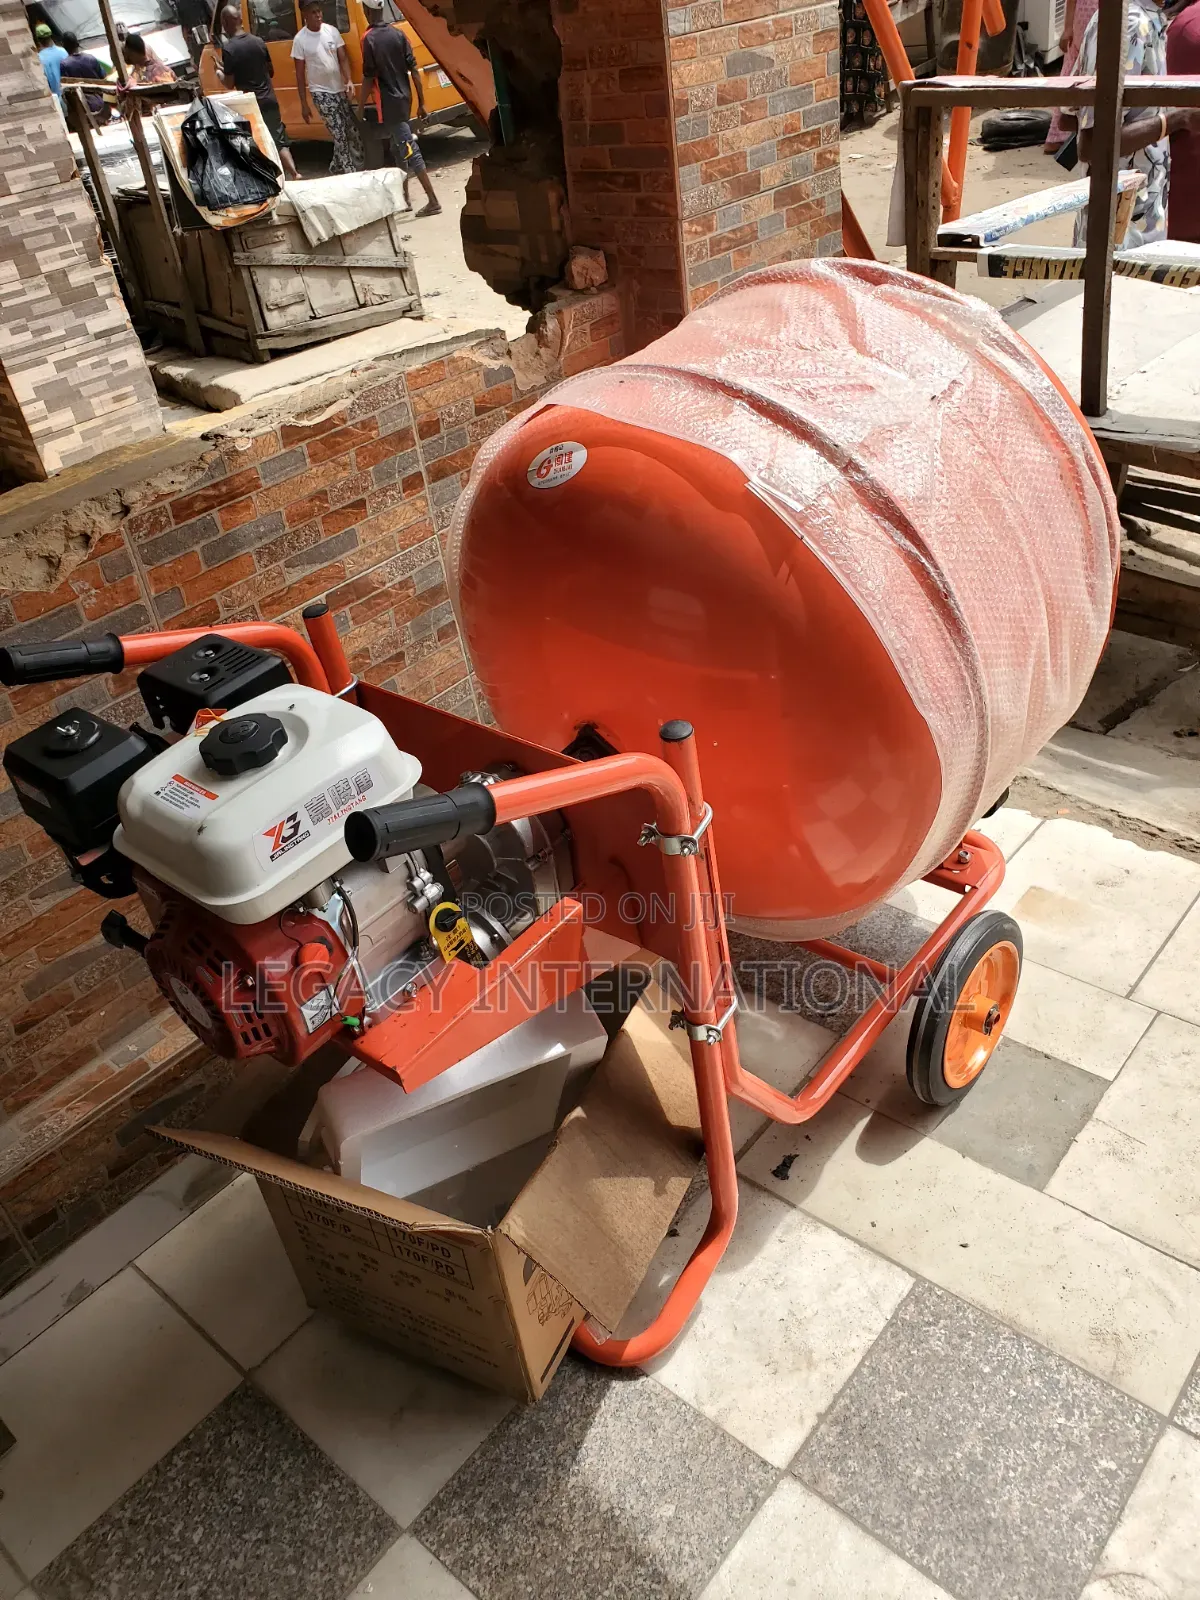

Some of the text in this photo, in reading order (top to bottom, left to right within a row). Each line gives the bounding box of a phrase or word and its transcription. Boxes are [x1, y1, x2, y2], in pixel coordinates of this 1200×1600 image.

[1001, 256, 1086, 280] HANGE
[327, 795, 367, 825] JIALINGTANG
[270, 830, 311, 862] JIALINGTANG
[306, 1209, 352, 1234] 170F/P
[391, 1227, 451, 1259] 170F/PD
[396, 1244, 455, 1277] 170F/PD
